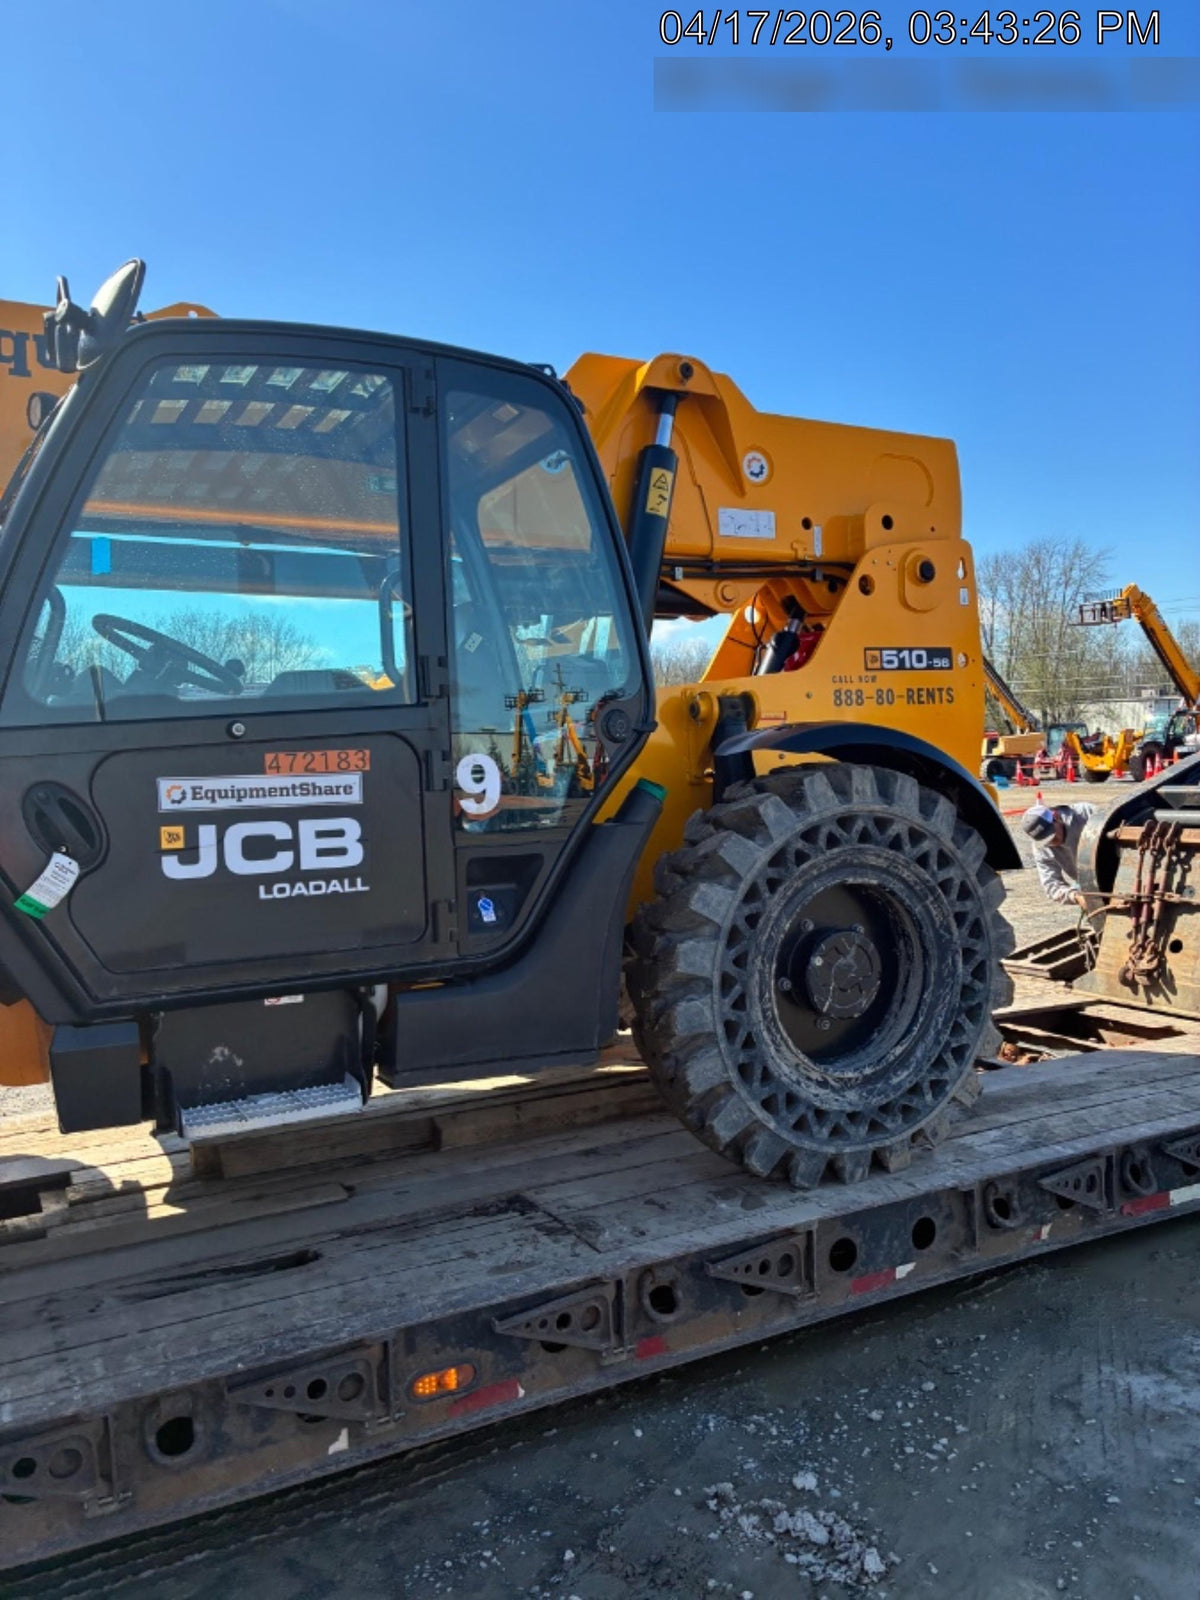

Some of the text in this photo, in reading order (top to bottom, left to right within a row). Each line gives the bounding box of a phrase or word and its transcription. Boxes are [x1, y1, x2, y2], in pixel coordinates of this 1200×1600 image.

[831, 675, 854, 684] CALL
[833, 687, 955, 707] 888-80-RENTS
[267, 750, 368, 774] 472183
[190, 782, 353, 802] EquipmentShare
[456, 753, 502, 815] 9
[161, 817, 364, 880] JCB
[259, 877, 370, 900] LOADALL
